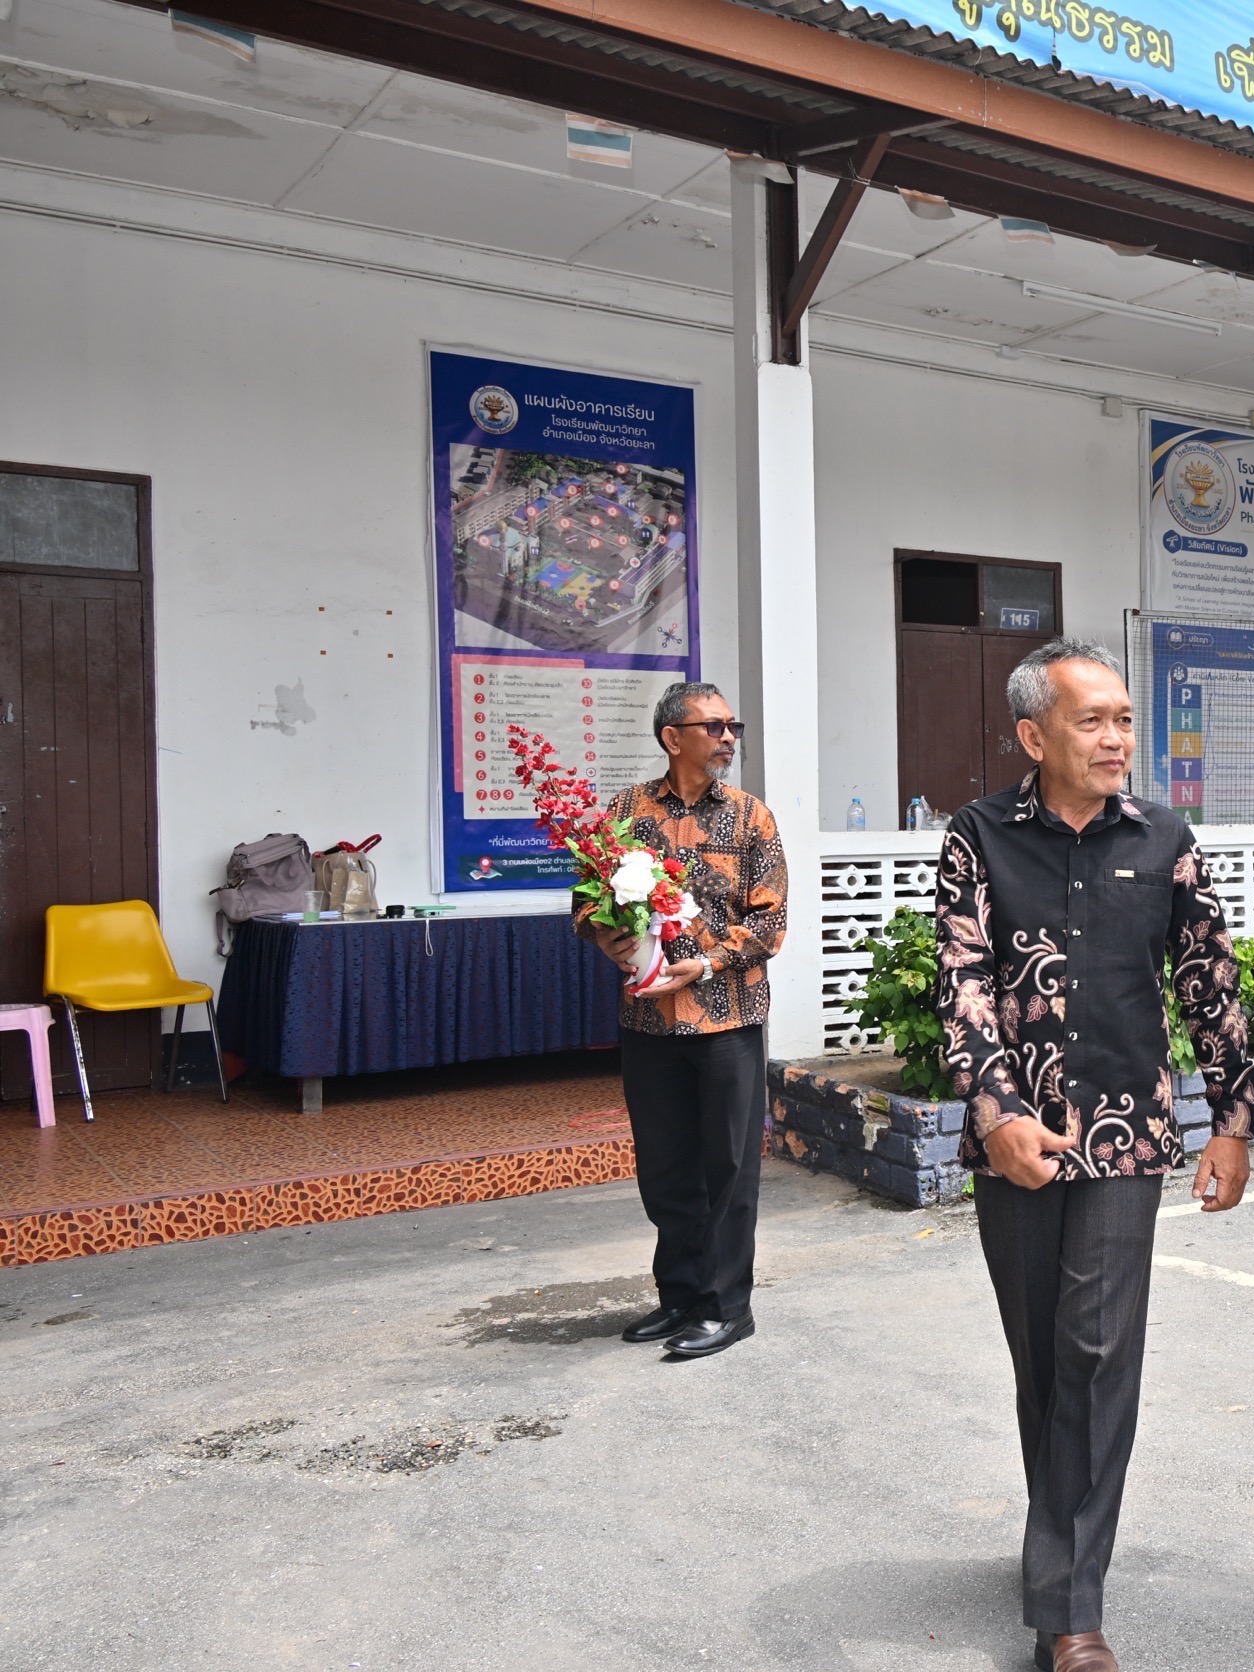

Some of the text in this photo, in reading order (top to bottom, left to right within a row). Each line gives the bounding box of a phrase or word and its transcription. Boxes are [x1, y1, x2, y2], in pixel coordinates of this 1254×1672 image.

[524, 393, 655, 421] แผนผังอาคารเรียน
[551, 414, 647, 437] โรงเรียนพัฒนาวิทยา
[542, 426, 655, 450] อำเภอเมือง จังหวัดยะลา
[1188, 540, 1243, 555] วิสัยทัศน์ (Vision)
[1010, 613, 1030, 626] 115
[1181, 688, 1192, 704] P
[1181, 712, 1193, 729] H
[1181, 737, 1193, 753] A
[1181, 761, 1192, 777] T
[1181, 785, 1193, 801] N
